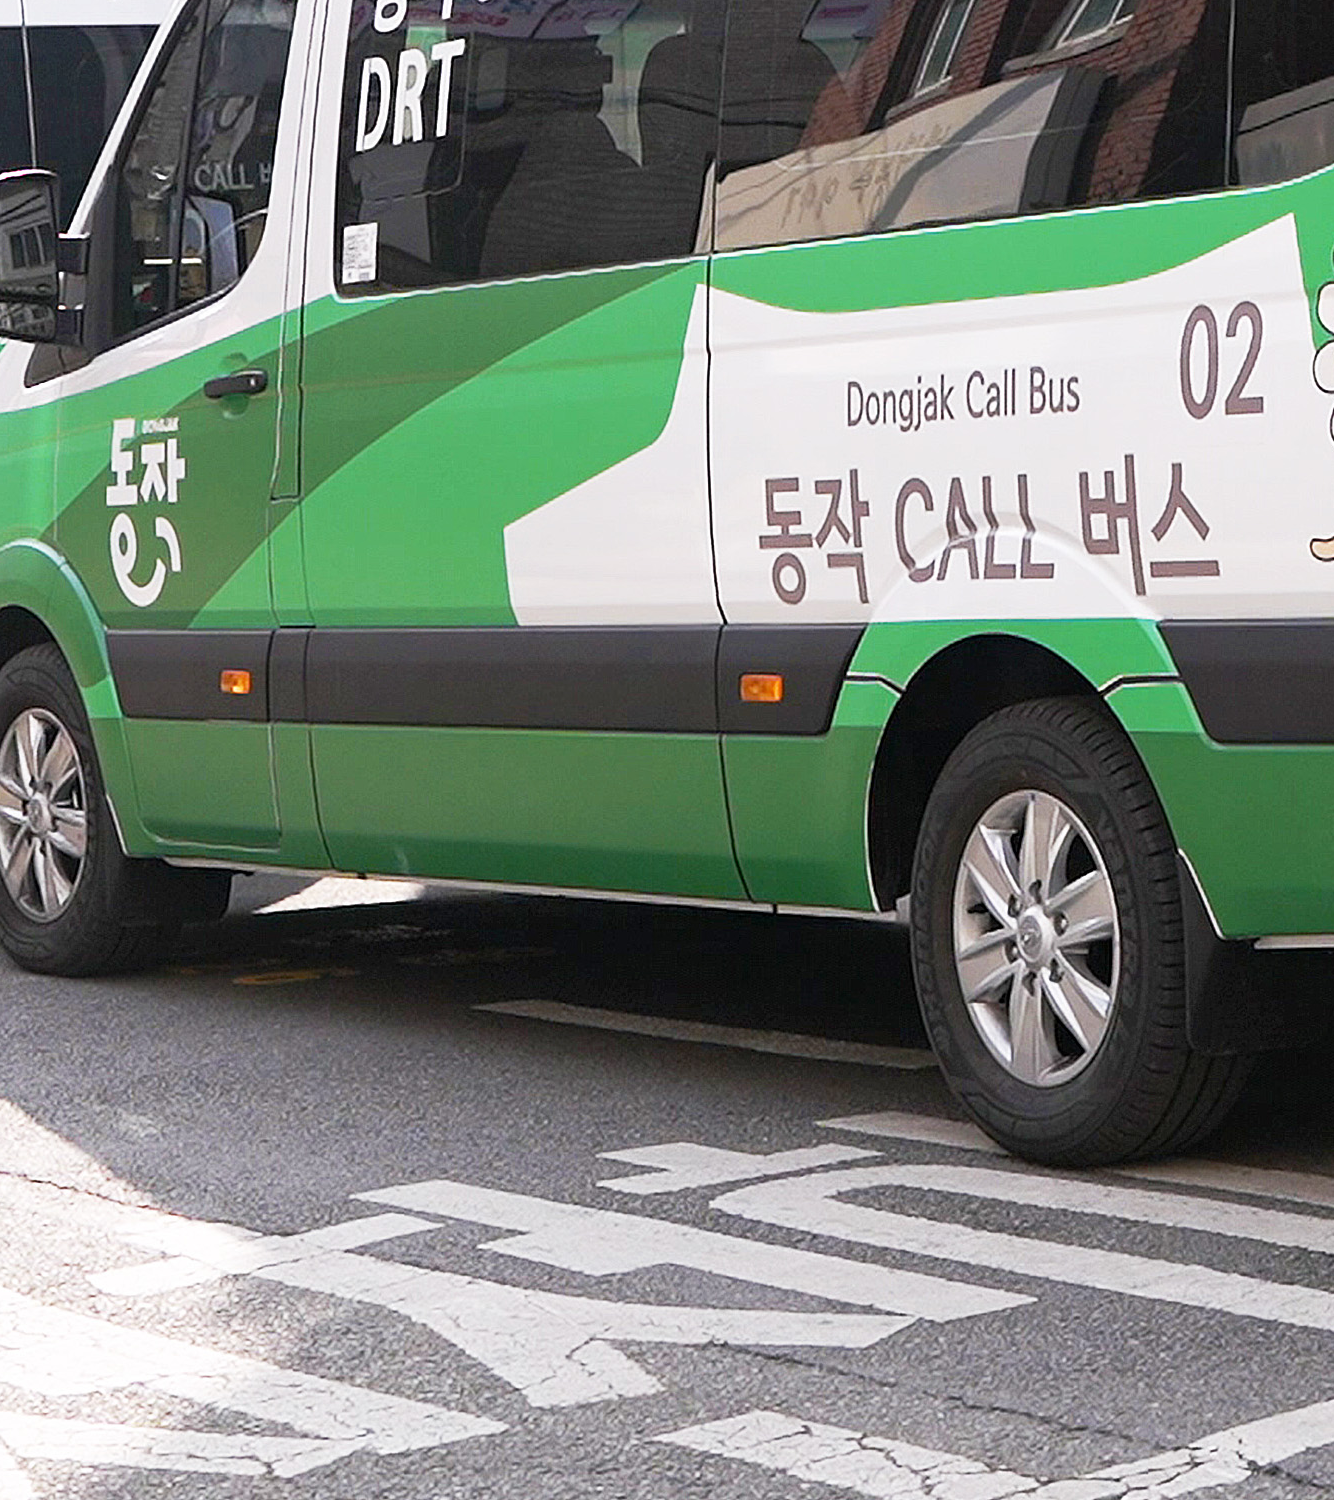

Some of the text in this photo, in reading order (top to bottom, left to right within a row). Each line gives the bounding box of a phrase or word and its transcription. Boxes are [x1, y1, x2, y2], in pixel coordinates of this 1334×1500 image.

[355, 38, 465, 152] DRT
[847, 301, 1265, 432] Dongjak Call Bus 02
[759, 454, 1220, 605] 동작 CALL 버스
